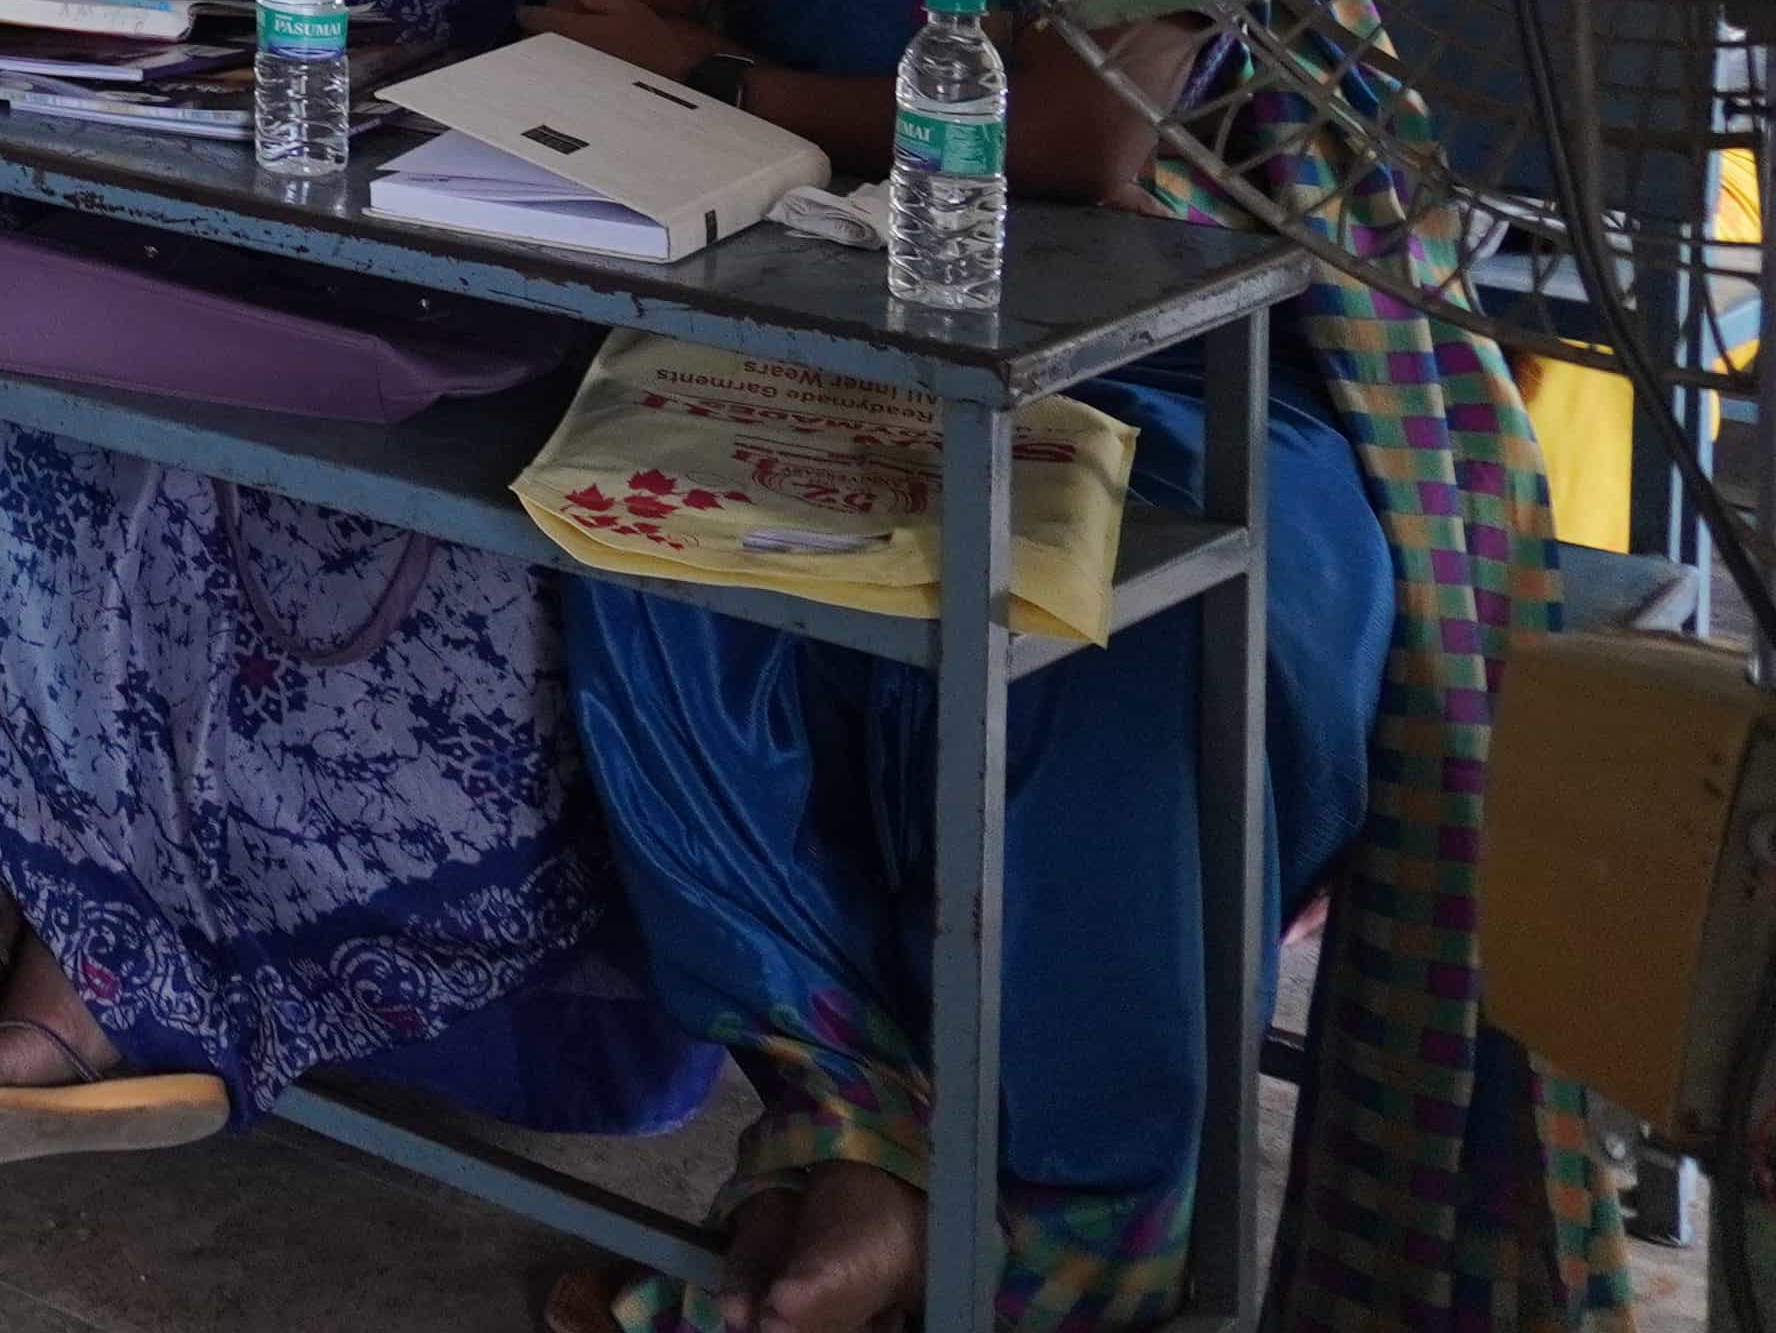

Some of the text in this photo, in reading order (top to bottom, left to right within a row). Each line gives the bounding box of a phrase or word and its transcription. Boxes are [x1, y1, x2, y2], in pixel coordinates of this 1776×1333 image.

[275, 19, 341, 36] PASUMAI
[743, 359, 823, 388] Wears
[656, 367, 935, 424] Readymade Garments
